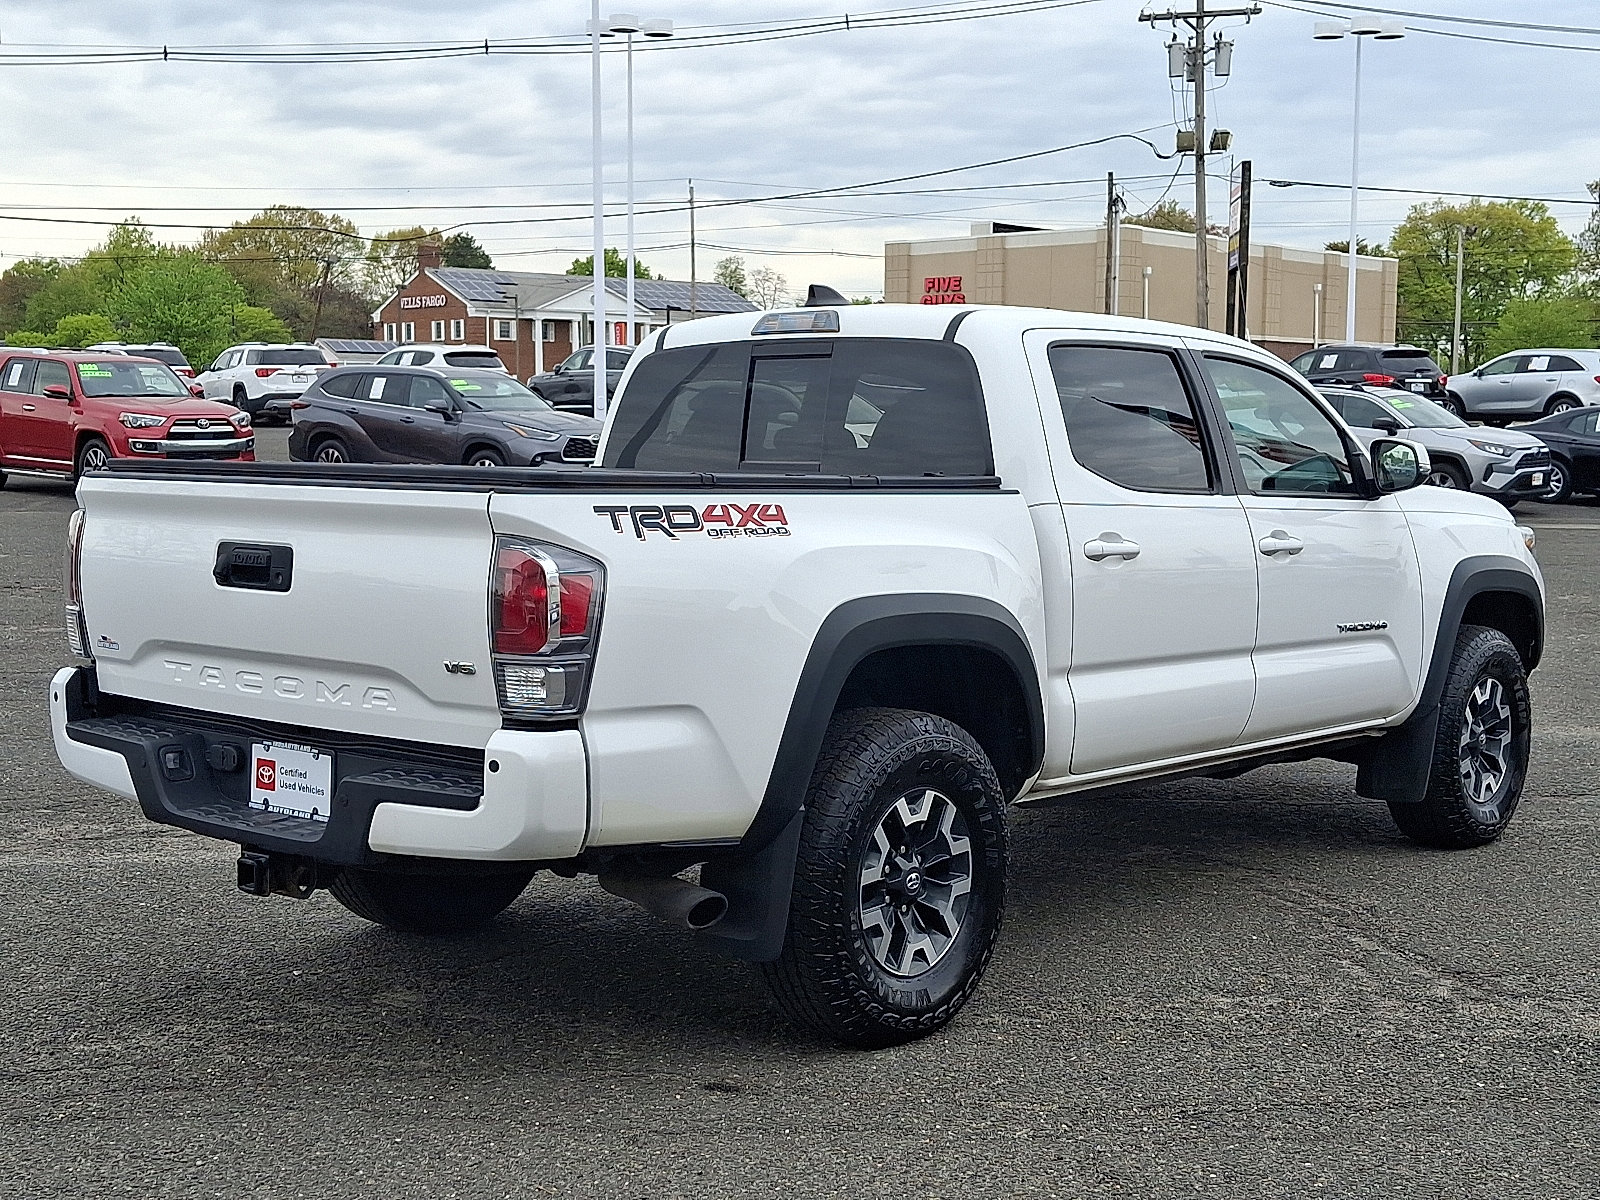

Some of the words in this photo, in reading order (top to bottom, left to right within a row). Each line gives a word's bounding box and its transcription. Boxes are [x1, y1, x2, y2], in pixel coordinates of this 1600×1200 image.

[924, 276, 962, 293] FIVE
[421, 295, 446, 308] FARGO
[706, 527, 742, 539] OFF
[744, 526, 791, 538] ROAD
[233, 553, 265, 565] TOYOTA
[443, 660, 476, 675] V6
[163, 659, 397, 712] TACOMA
[280, 766, 308, 779] Certified
[280, 779, 297, 791] Used
[297, 782, 325, 796] Vehicles
[267, 805, 311, 819] AUTOLAND
